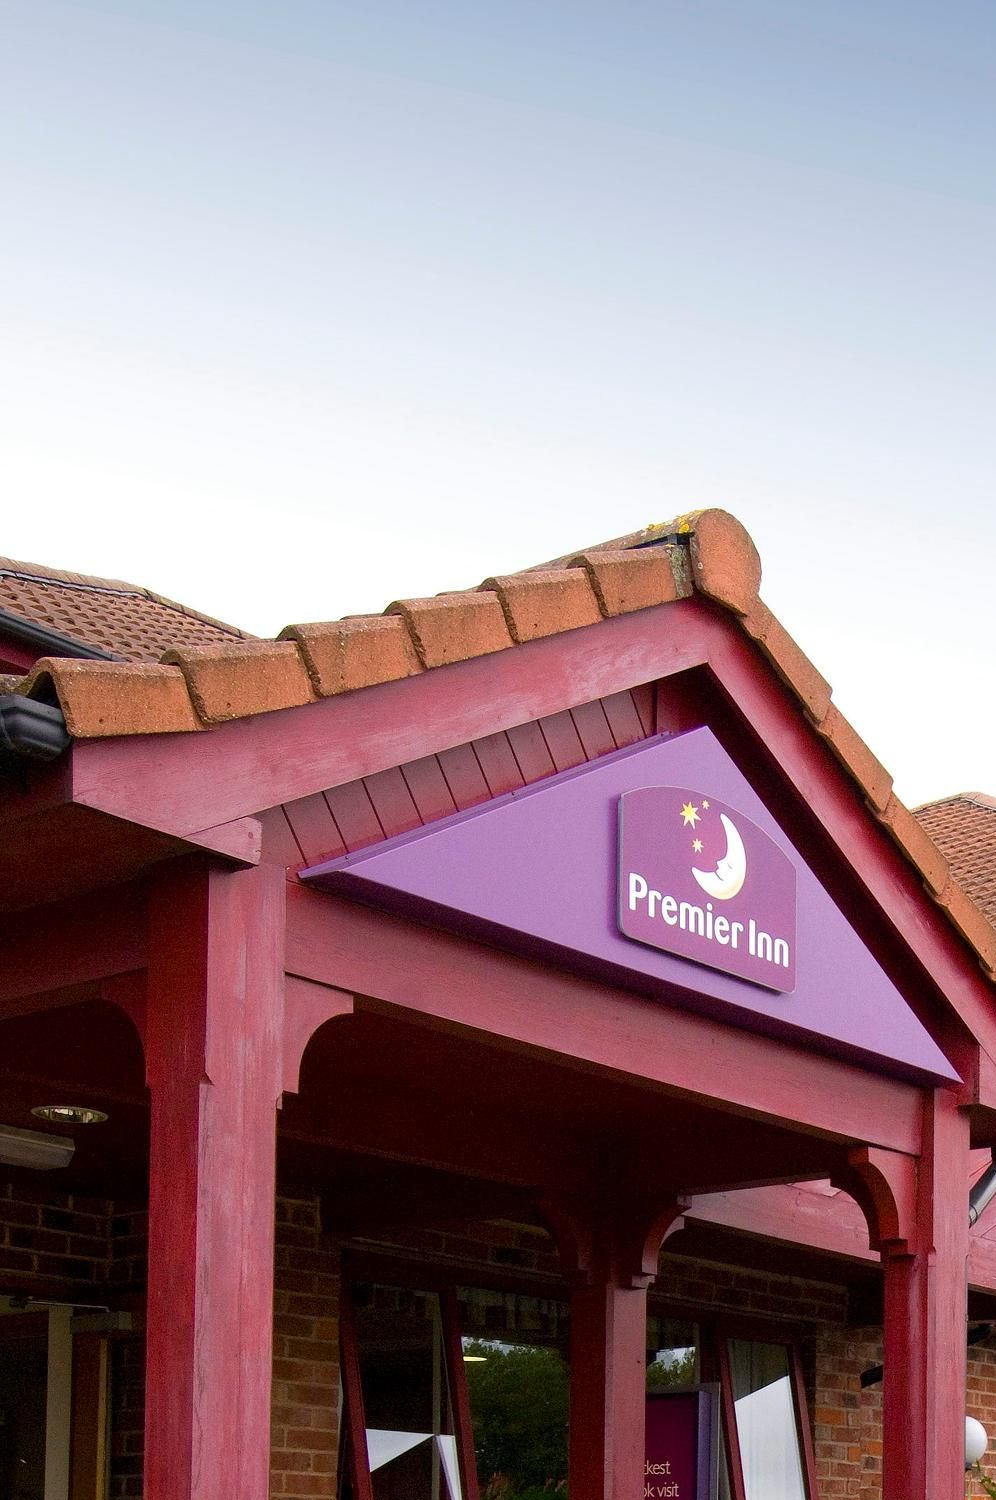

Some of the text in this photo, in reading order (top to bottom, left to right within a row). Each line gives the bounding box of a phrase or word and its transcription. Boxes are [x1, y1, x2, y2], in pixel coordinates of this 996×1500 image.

[628, 872, 789, 968] Premier Inn
[657, 1481, 680, 1498] visit
